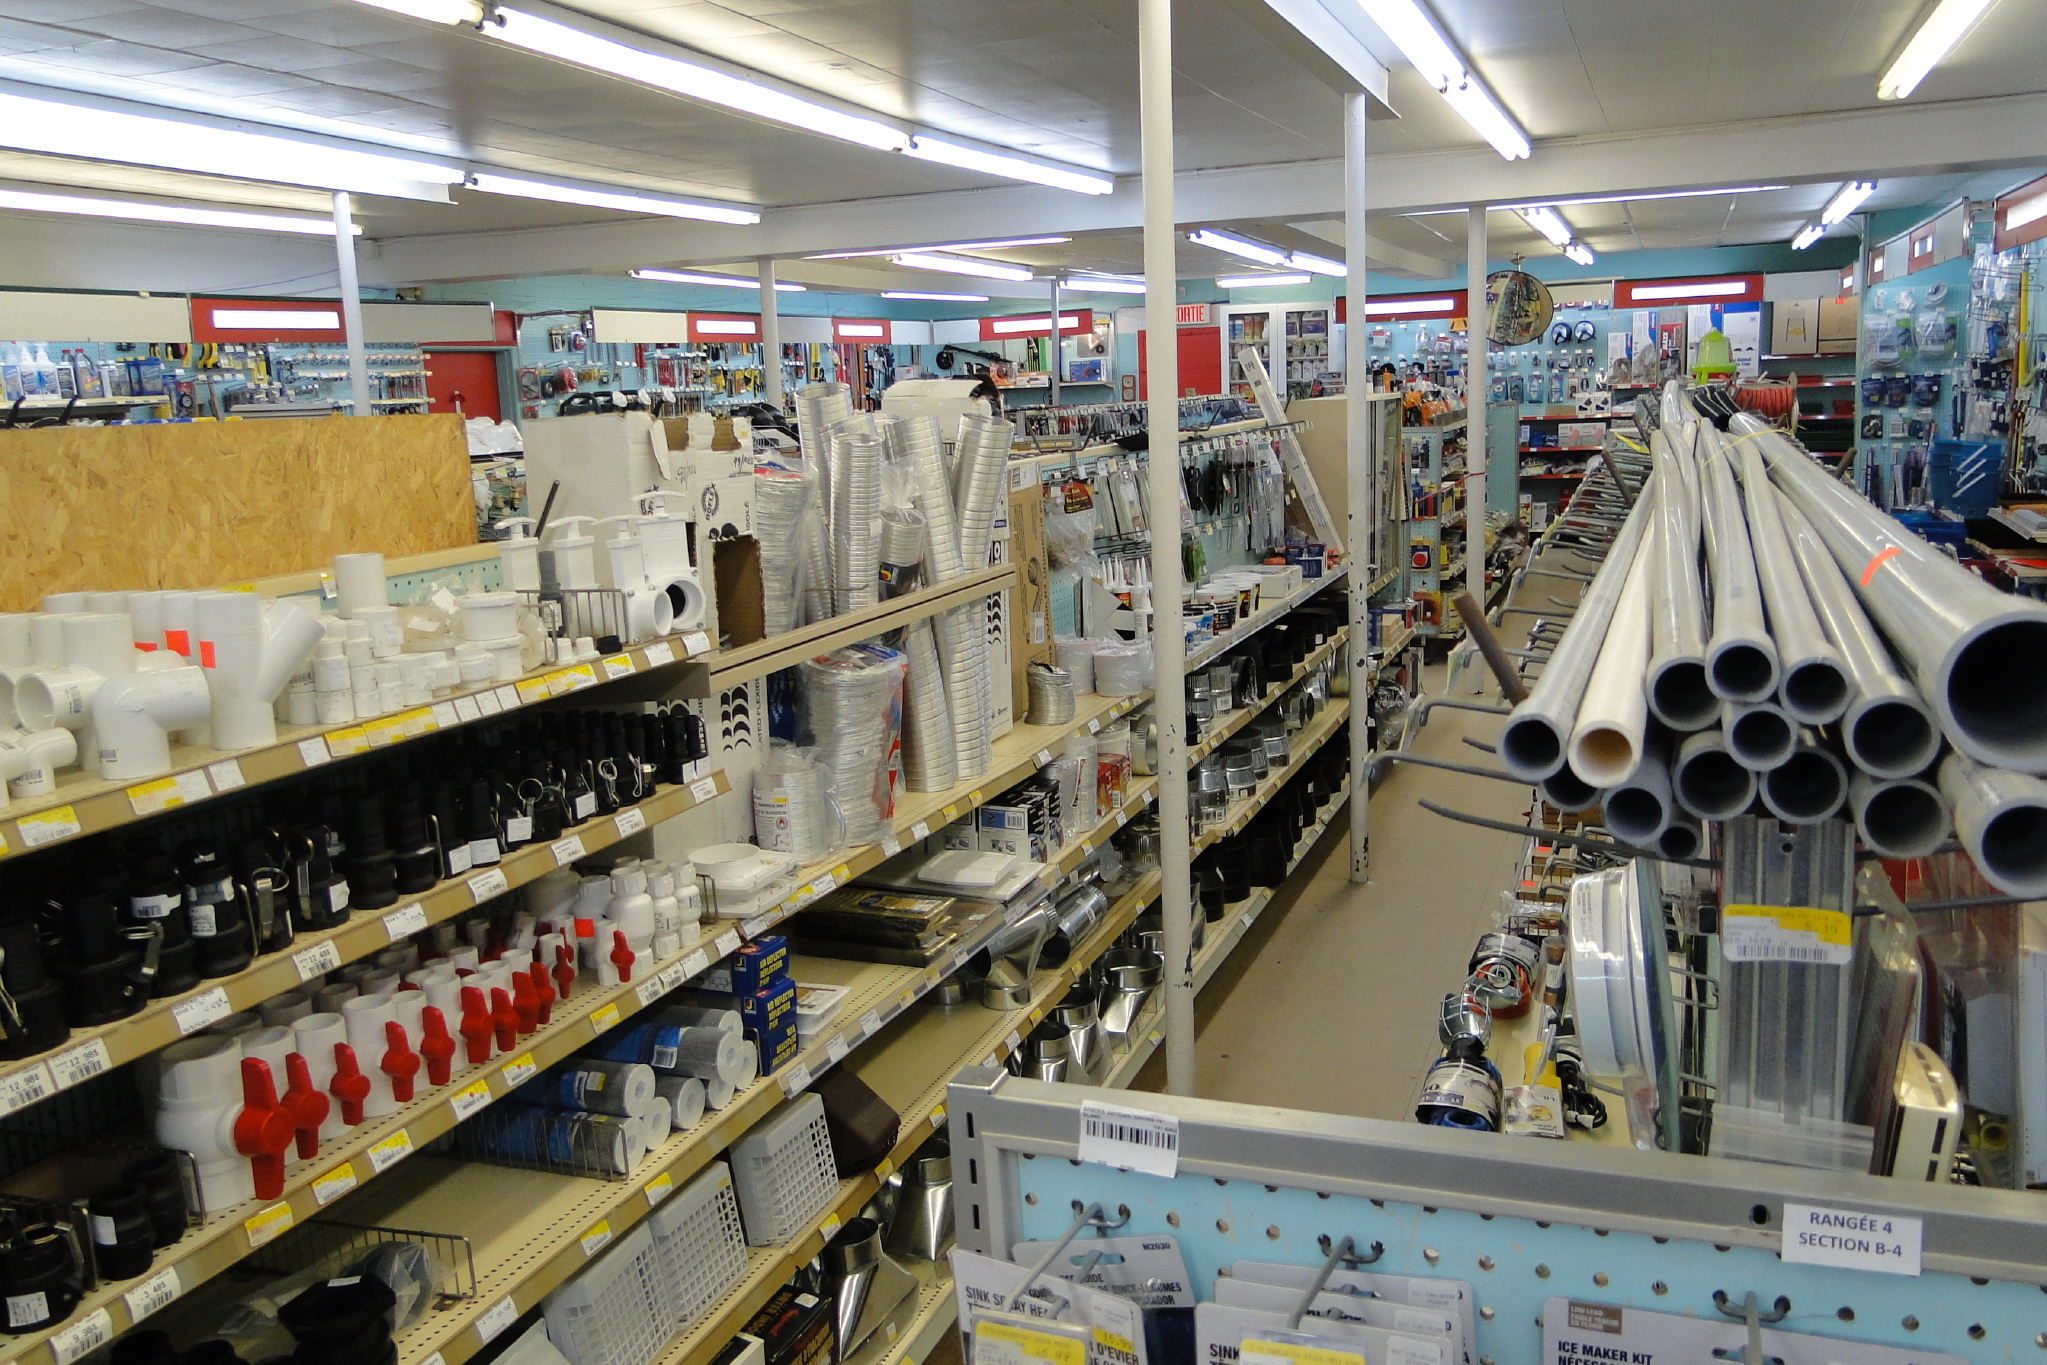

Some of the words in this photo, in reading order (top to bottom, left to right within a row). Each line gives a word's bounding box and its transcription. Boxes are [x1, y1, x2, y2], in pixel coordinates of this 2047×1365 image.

[1176, 305, 1205, 322] ORTIE
[705, 482, 716, 521] BOFLEX
[70, 1056, 81, 1067] 12
[83, 1049, 99, 1062] 98$
[9, 1081, 21, 1092] 12
[24, 1073, 40, 1086] 98$
[1810, 1212, 1878, 1232] RANGÉE
[1883, 1221, 1892, 1234] 4
[1799, 1232, 1870, 1253] SECTION
[1875, 1242, 1902, 1257] B-4
[965, 1286, 991, 1304] SINK
[993, 1293, 1026, 1313] SPAY
[1209, 1343, 1240, 1360] SINK
[1558, 1340, 1578, 1354] ICE
[1582, 1344, 1628, 1362] MAKER
[1632, 1352, 1654, 1365] KIT
